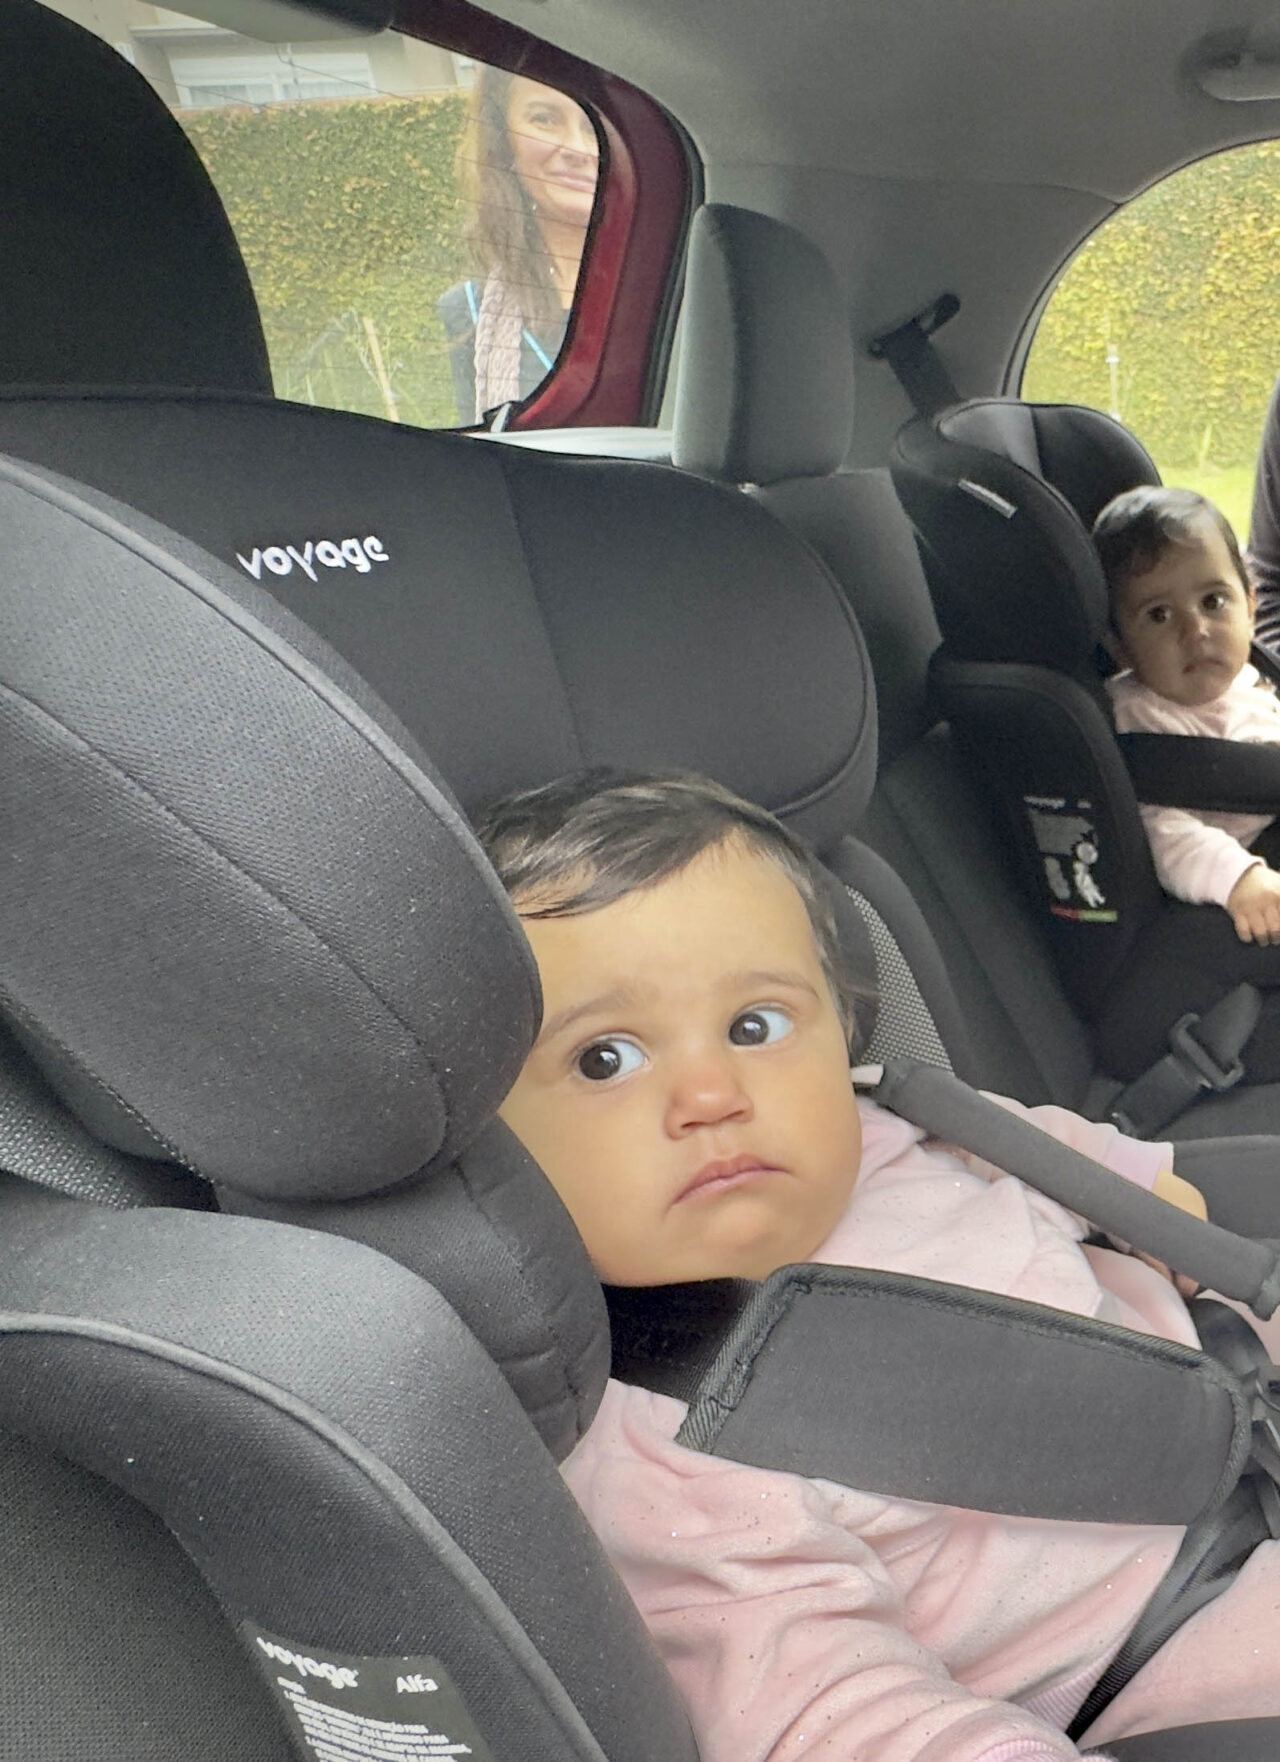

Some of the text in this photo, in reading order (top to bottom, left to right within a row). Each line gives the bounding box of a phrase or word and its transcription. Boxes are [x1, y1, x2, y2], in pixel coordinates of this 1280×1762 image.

[236, 536, 390, 582] voyage
[256, 1636, 359, 1690] voyage
[396, 1673, 439, 1693] Alfa
